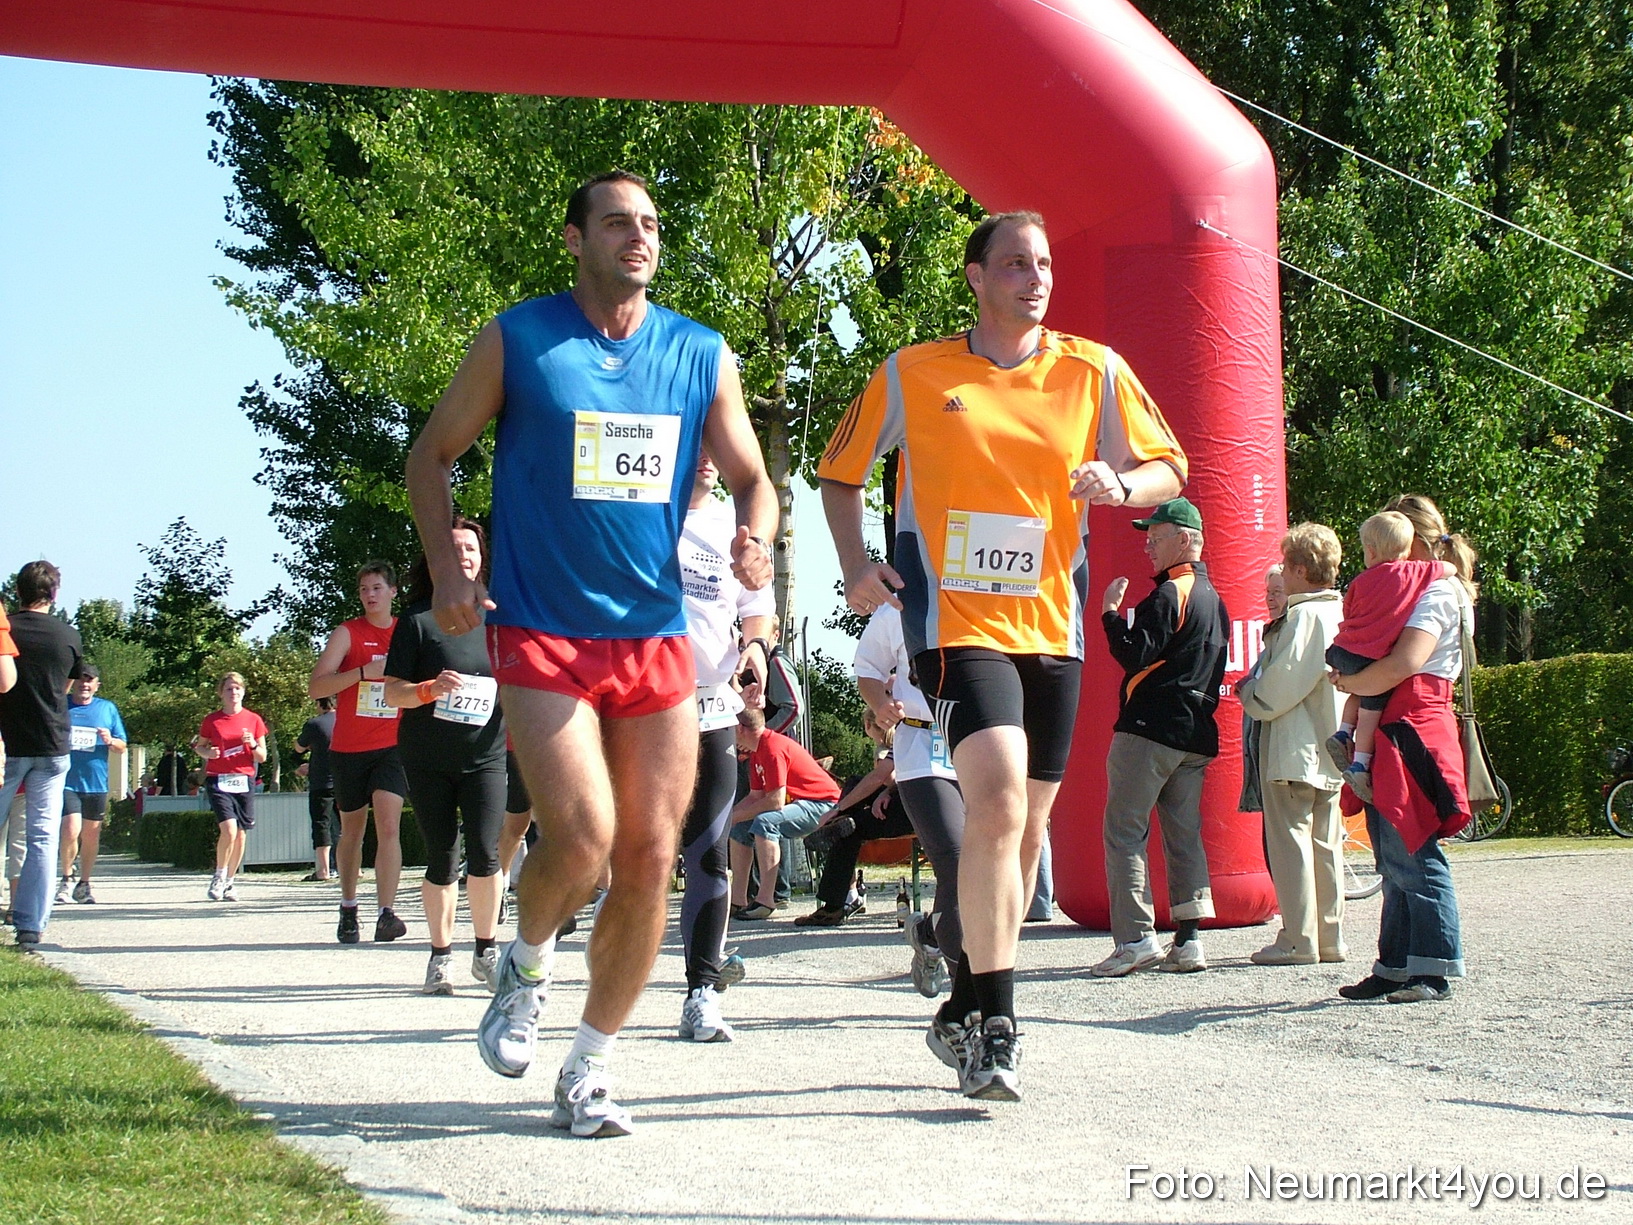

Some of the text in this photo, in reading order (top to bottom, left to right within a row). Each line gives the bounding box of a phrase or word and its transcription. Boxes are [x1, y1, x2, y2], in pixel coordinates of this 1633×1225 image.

[605, 421, 654, 439] Sascha
[580, 445, 587, 458] D
[615, 452, 662, 477] 643
[974, 547, 1034, 573] 1073
[682, 582, 721, 593] umarkter
[942, 577, 980, 588] BOCK
[1001, 583, 1037, 592] PFLEIDERER
[682, 588, 719, 601] Stadtlauf
[1218, 684, 1232, 697] er
[374, 697, 387, 708] 16
[453, 695, 490, 712] 2775
